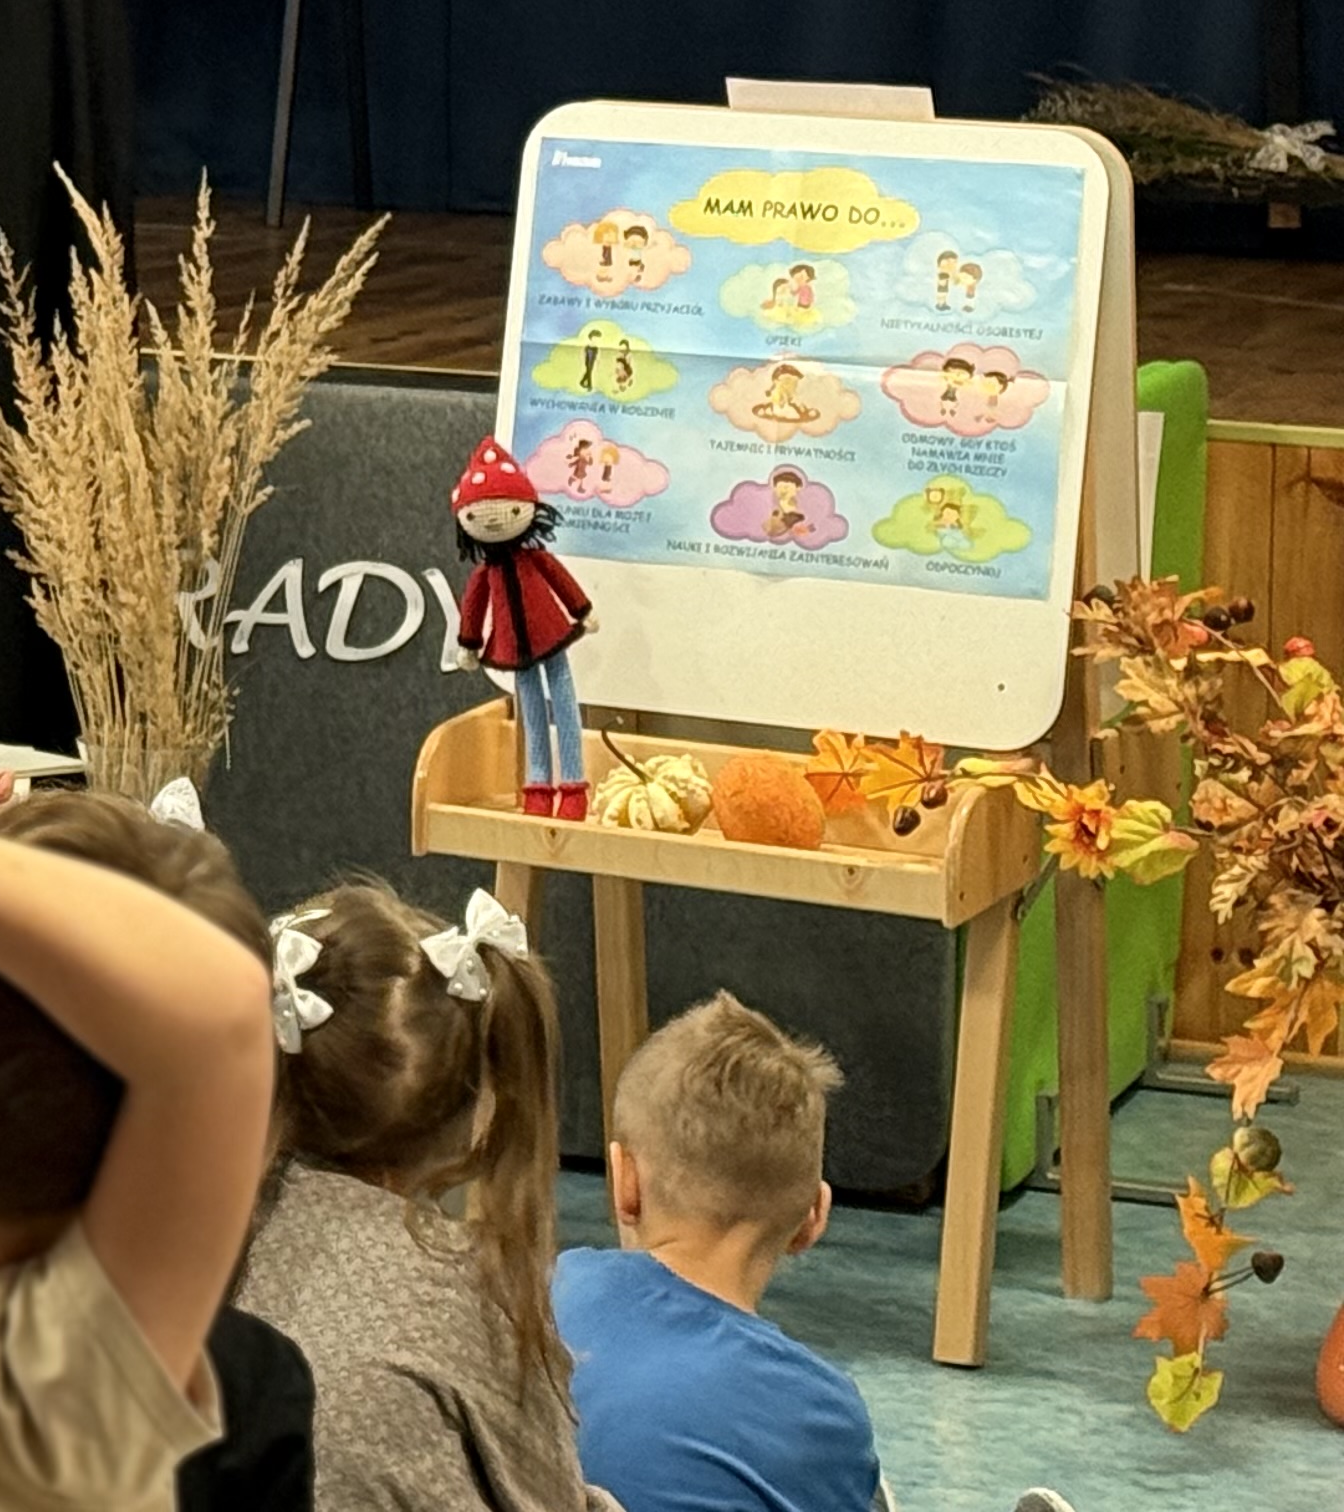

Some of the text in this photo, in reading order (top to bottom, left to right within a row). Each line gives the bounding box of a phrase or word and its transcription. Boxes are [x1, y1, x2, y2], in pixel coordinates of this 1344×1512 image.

[703, 196, 906, 228] MAM PRAWO DO...
